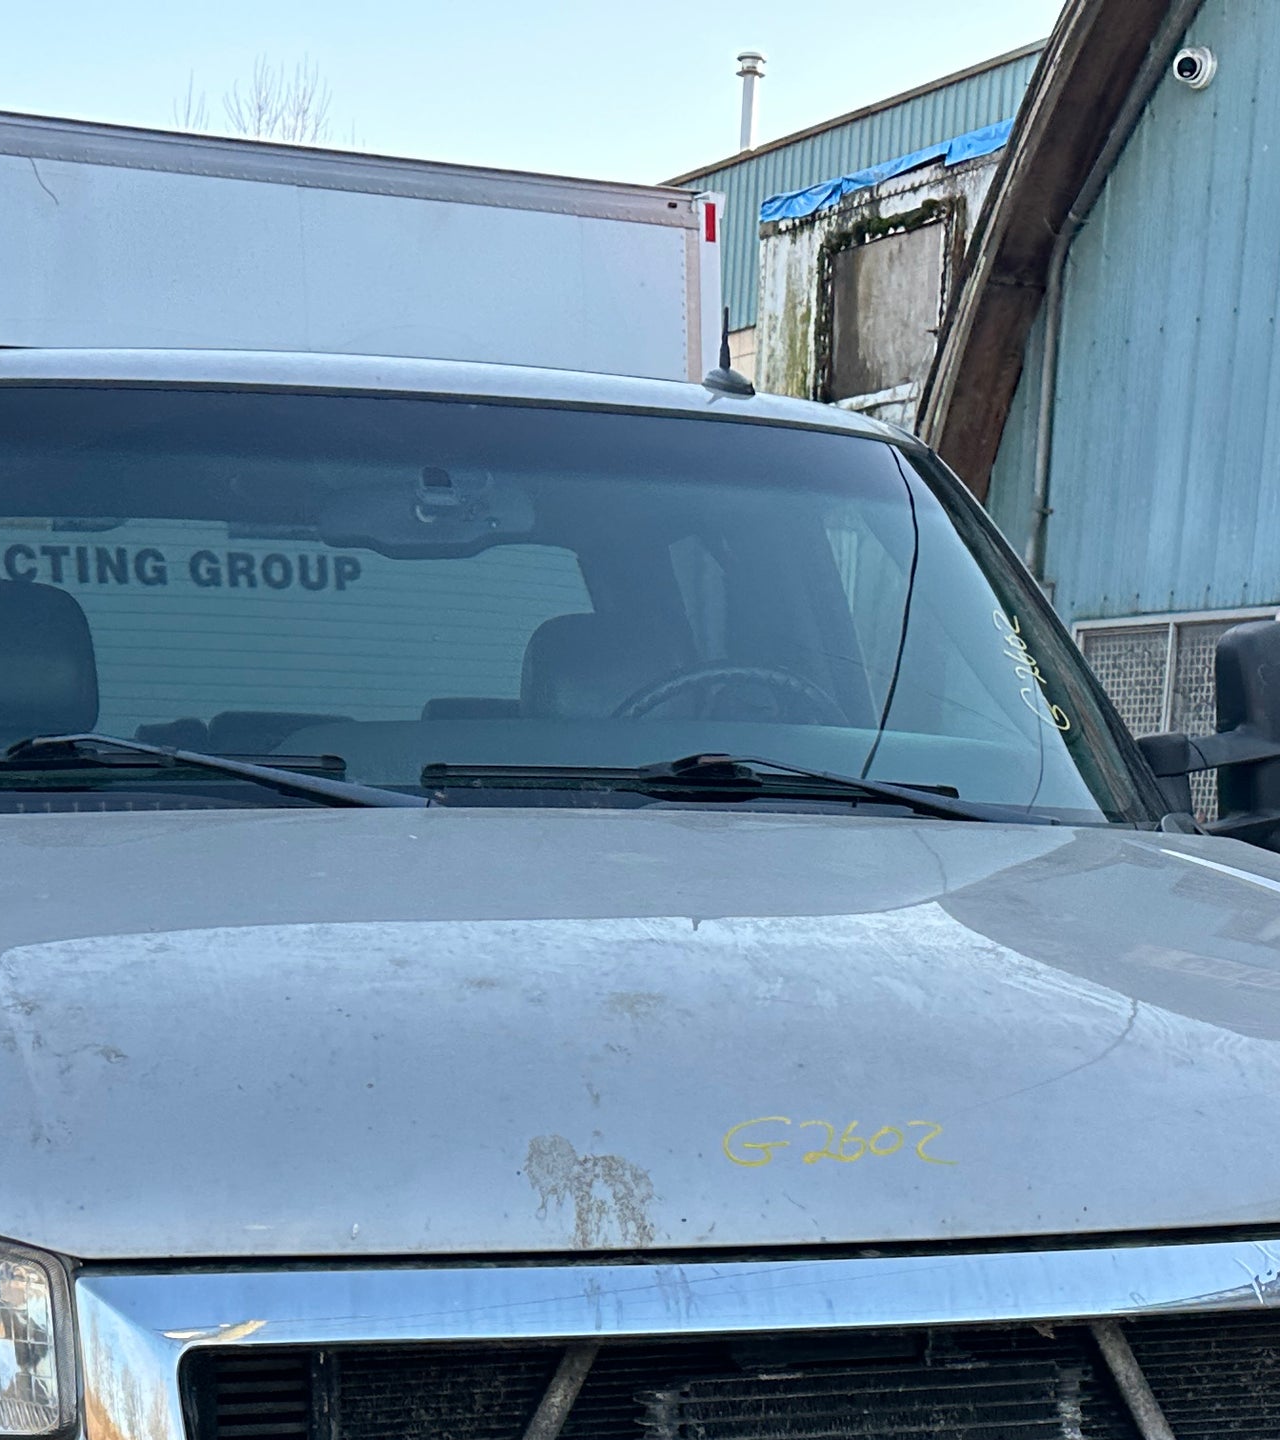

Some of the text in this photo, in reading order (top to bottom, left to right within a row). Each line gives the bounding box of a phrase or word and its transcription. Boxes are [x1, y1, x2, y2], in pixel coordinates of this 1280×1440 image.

[189, 550, 362, 591] GROUP
[992, 609, 1071, 731] G2602
[723, 1115, 960, 1167] G2602
